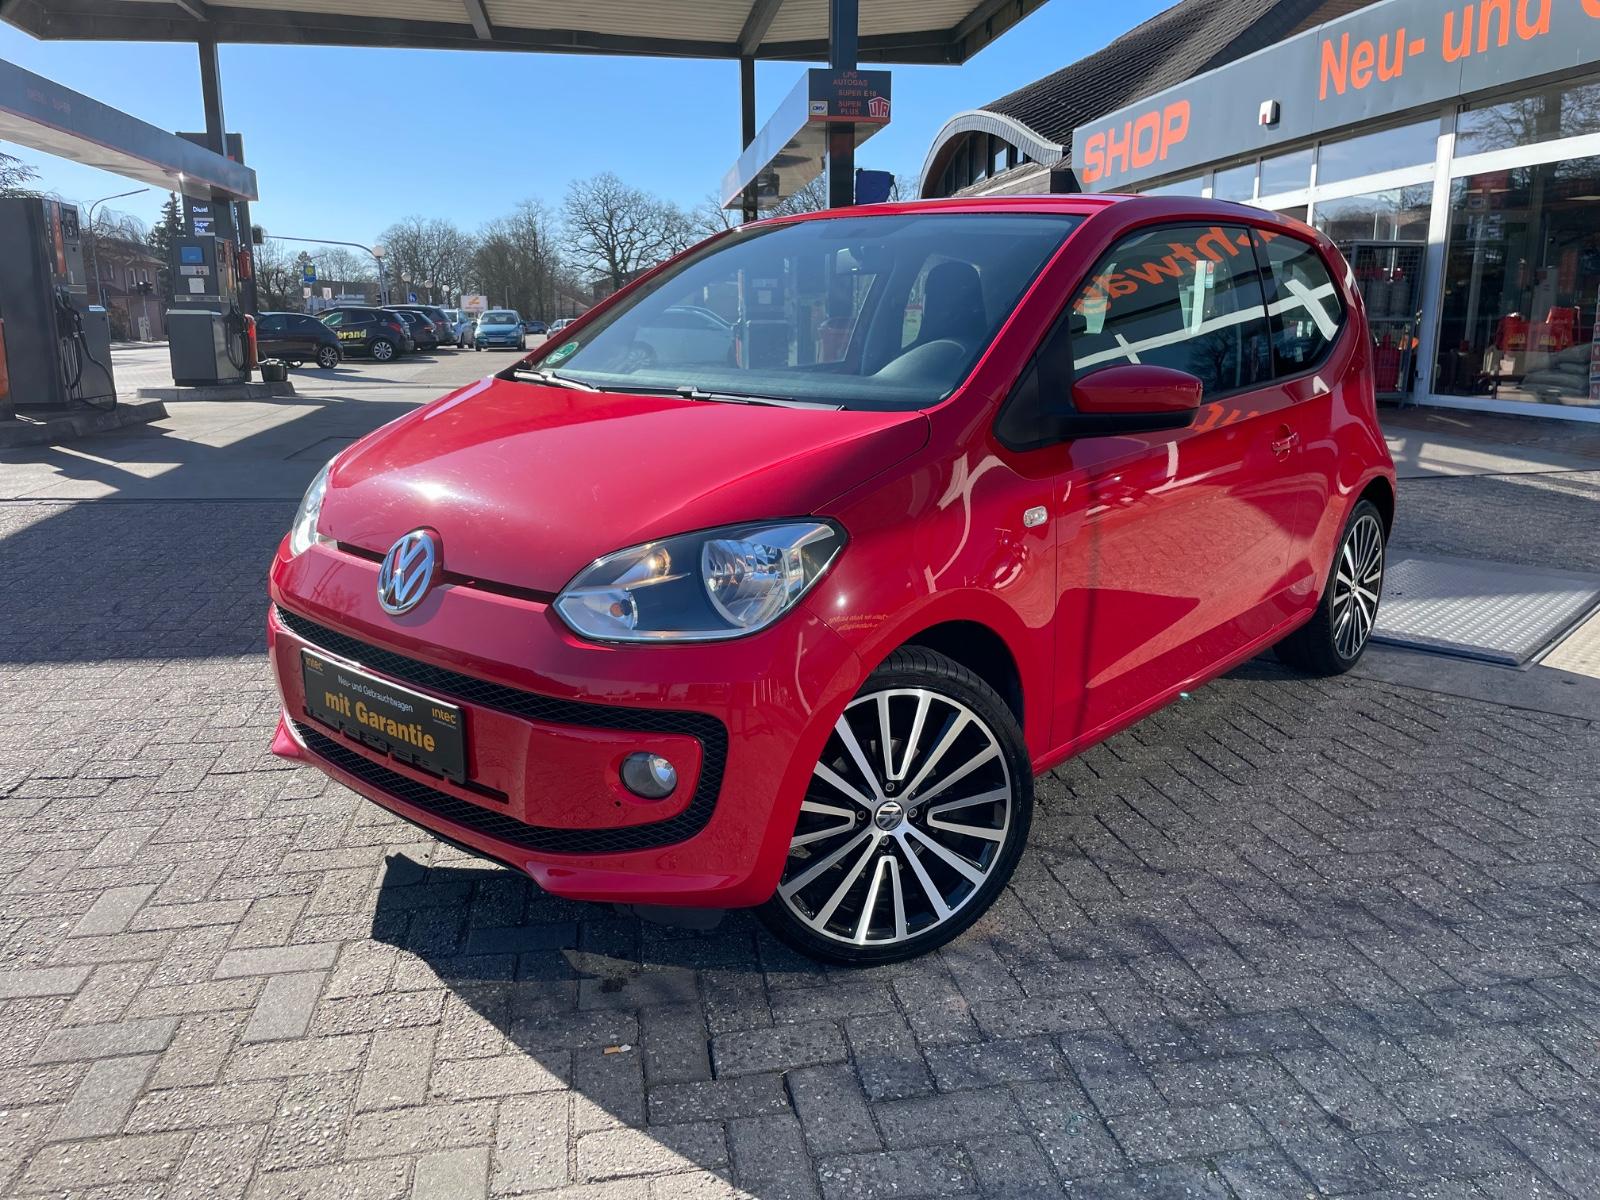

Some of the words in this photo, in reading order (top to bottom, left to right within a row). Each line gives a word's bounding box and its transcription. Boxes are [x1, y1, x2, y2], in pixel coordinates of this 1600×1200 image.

[1319, 28, 1425, 101] Neu-
[1442, 0, 1550, 63] und
[832, 79, 869, 87] AUTOGAS
[838, 89, 862, 97] SUPER
[838, 100, 862, 108] SUPER
[840, 108, 860, 116] PLUS
[1082, 99, 1191, 184] SHOP
[351, 681, 363, 694] und
[363, 684, 414, 713] Gebrauchtwagen
[324, 690, 352, 717] mit
[355, 700, 436, 752] Garantie
[431, 707, 457, 725] intec
